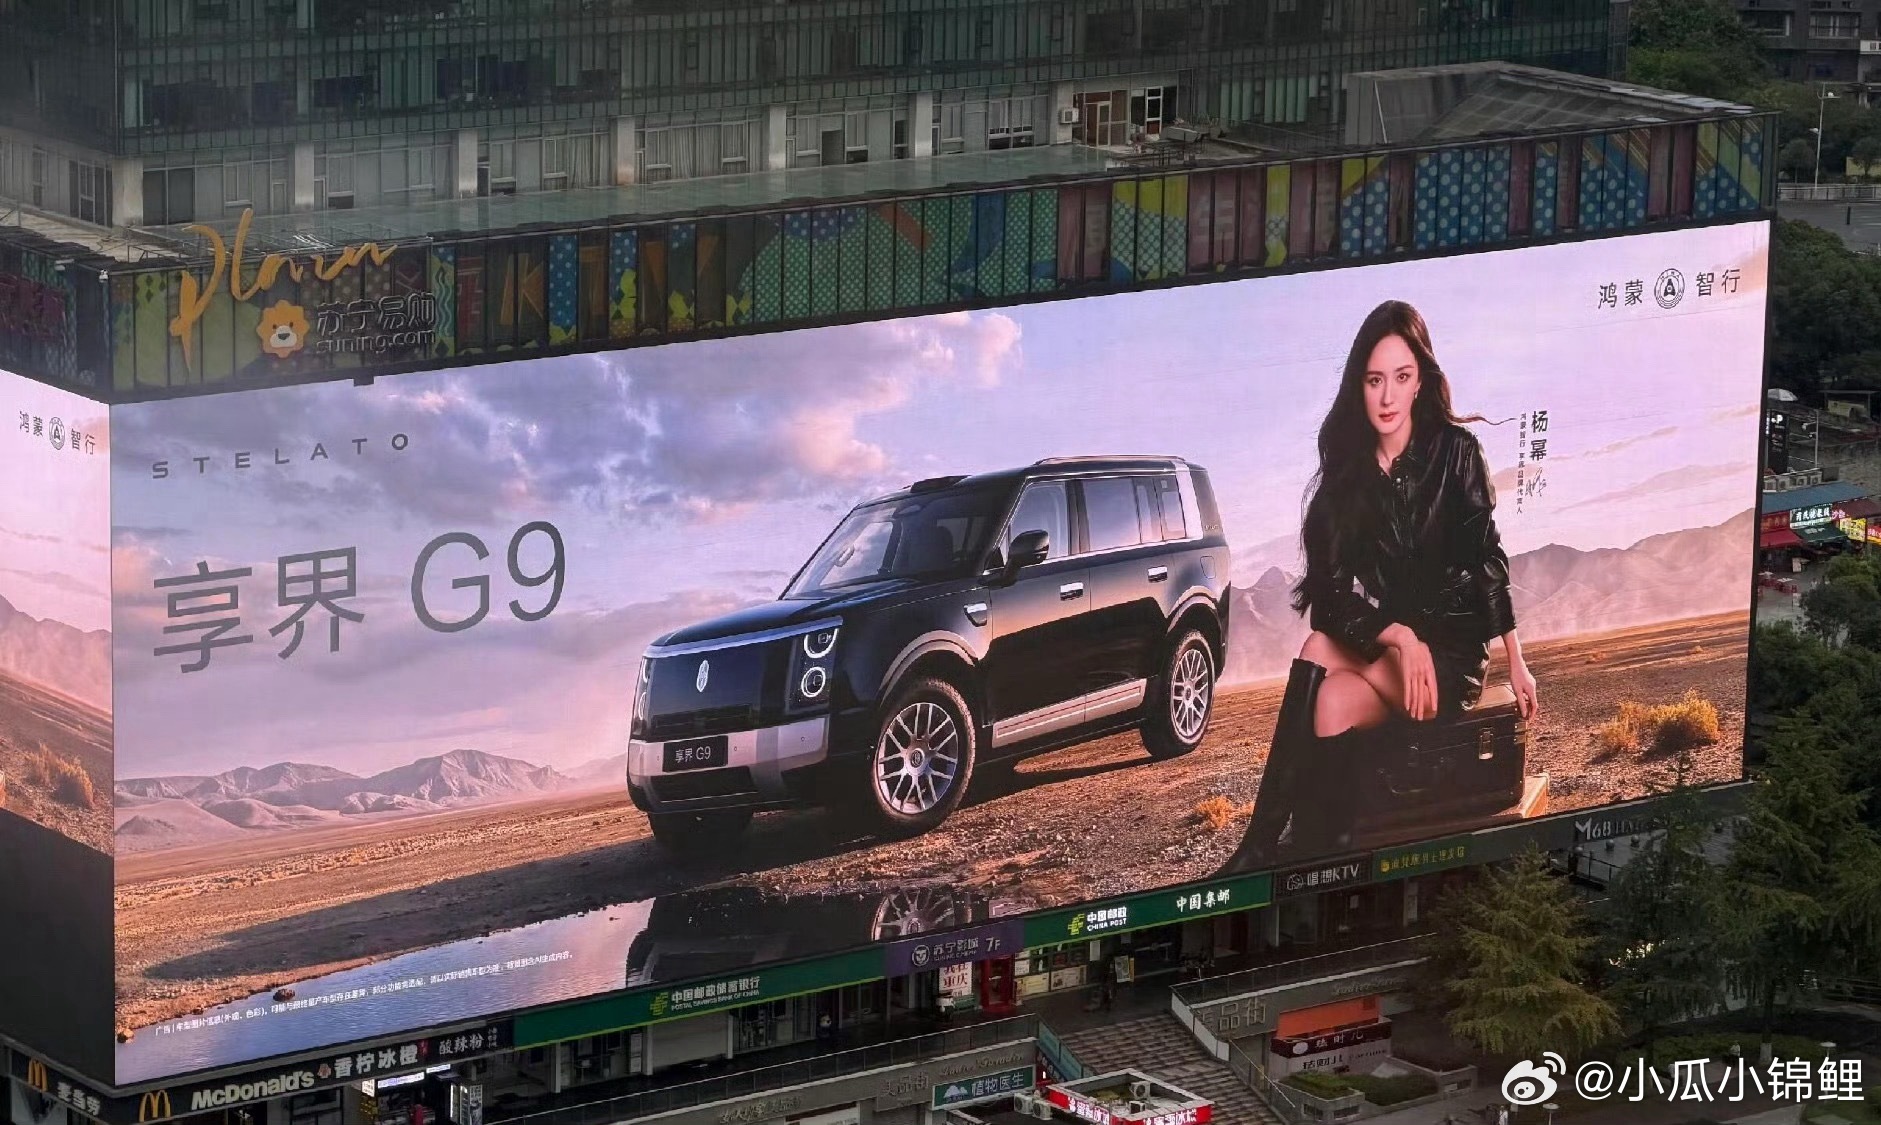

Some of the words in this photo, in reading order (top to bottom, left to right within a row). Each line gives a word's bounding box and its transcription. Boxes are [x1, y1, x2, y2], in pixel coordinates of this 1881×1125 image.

[1598, 278, 1643, 309] 鸿蒙
[1696, 268, 1741, 297] 智行
[316, 292, 436, 337] 苏宁易购
[316, 328, 436, 354] suning.com
[19, 410, 43, 437] 鸿蒙
[71, 428, 96, 455] 智行
[1529, 410, 1548, 461] 杨幂
[152, 433, 410, 480] STELATO
[153, 546, 366, 674] 享界
[411, 521, 566, 634] G9
[675, 748, 693, 764] 享界
[695, 745, 712, 761] G9
[1575, 817, 1612, 840] M68
[1176, 889, 1230, 912] 中国集邮
[1087, 906, 1127, 923] 中国邮政
[1087, 921, 1108, 932] CHINA
[1110, 917, 1127, 927] POST
[933, 938, 979, 956] 苏宁影城
[985, 937, 1001, 952] 7F
[671, 976, 760, 1004] 中国邮政储蓄银行
[671, 1001, 692, 1011] POSTAL
[693, 996, 717, 1007] SAVINGS
[718, 994, 733, 1003] BANK
[734, 992, 742, 1001] OF
[743, 989, 760, 998] CHINA
[438, 1034, 484, 1055] 酸辣粉
[334, 1044, 418, 1079] 香柠冰橙
[191, 1070, 316, 1111] McDonald's
[971, 1071, 1025, 1096] 植物医生
[57, 1081, 101, 1116] 麦当劳
